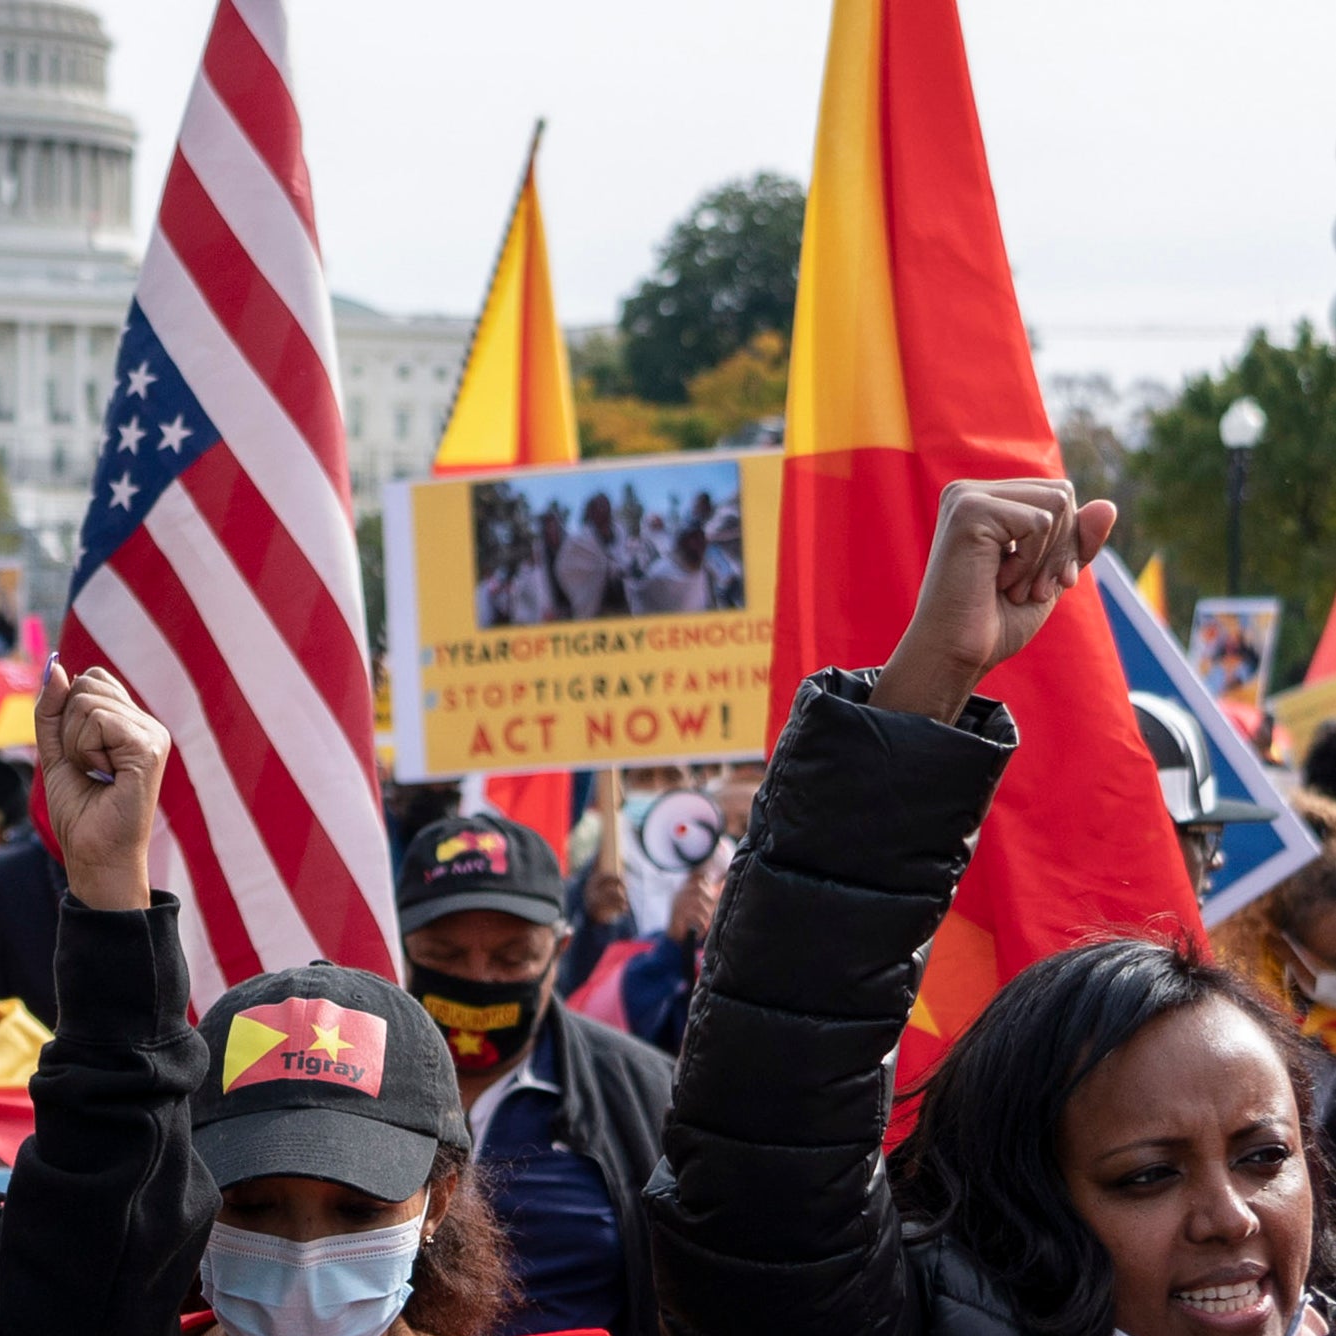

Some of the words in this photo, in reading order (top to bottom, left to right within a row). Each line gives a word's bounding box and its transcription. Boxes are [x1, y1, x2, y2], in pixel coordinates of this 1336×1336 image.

[469, 713, 557, 757] ACT
[584, 703, 731, 748] NOW!
[280, 1051, 366, 1082] Tigray
